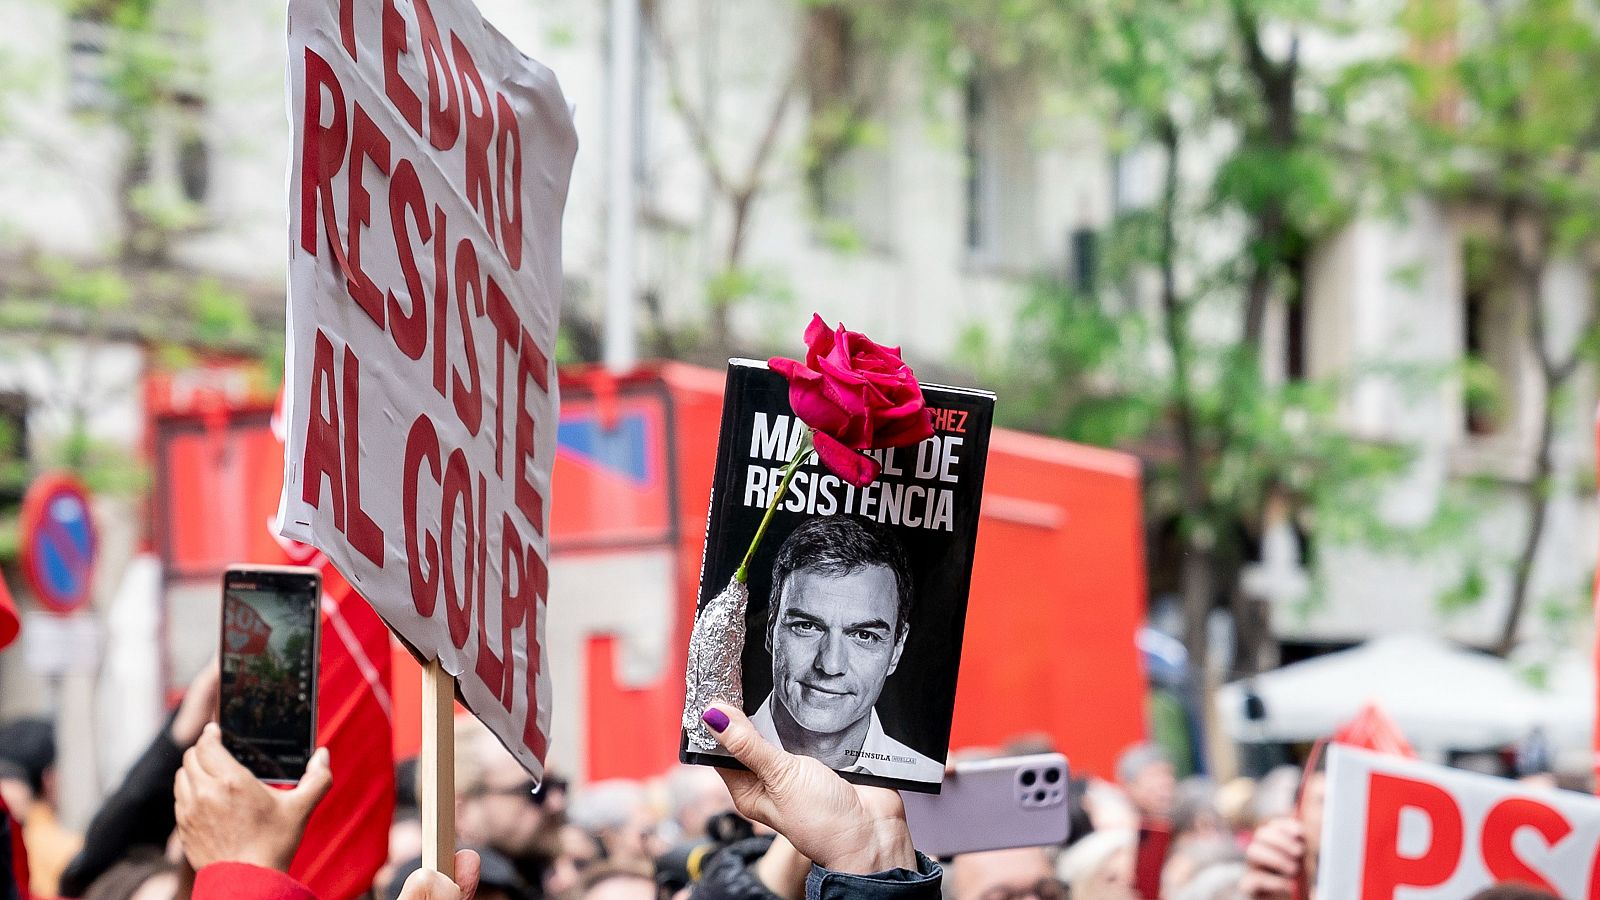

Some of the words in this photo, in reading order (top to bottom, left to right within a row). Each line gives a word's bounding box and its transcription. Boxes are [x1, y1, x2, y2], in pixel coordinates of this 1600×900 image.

[339, 0, 522, 271] EDRO
[301, 45, 549, 537] RESISTE
[302, 327, 384, 569] AL
[402, 413, 549, 768] GOLPE
[743, 464, 954, 532] RESISTENCIA
[915, 435, 964, 483] DE
[1360, 770, 1600, 900] PS
